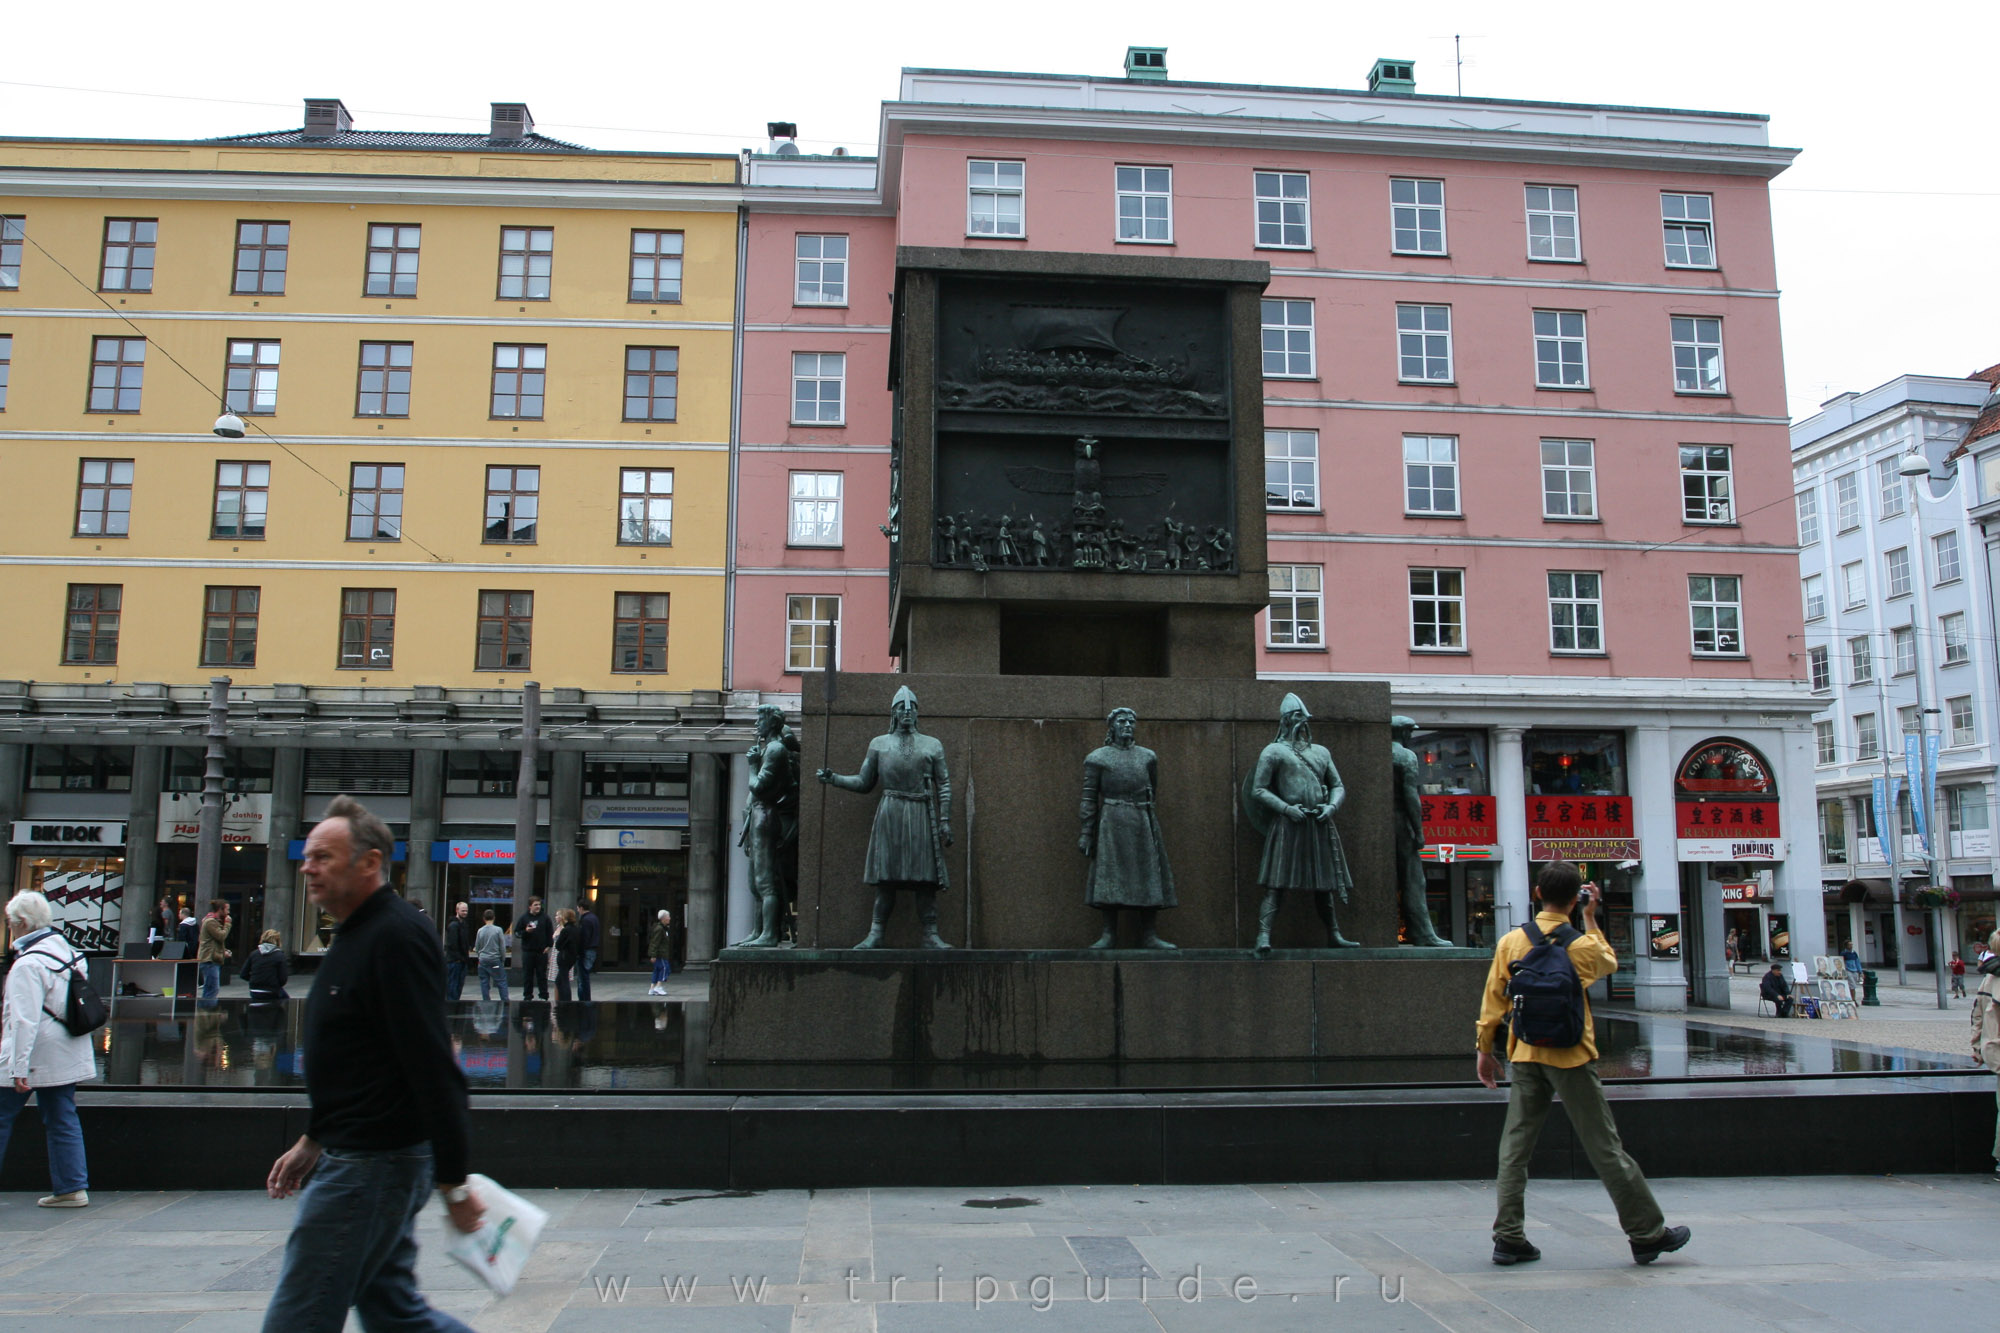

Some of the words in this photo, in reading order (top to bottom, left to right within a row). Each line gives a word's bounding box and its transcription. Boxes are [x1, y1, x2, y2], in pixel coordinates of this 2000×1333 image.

[1906, 738, 1914, 752] Tax
[232, 812, 263, 820] clothing
[1421, 800, 1486, 823] 宮酒樓
[31, 825, 63, 842] BIK
[62, 825, 104, 843] BOK
[1422, 826, 1490, 838] TAURANT
[1528, 827, 1573, 838] CHINA
[1577, 827, 1628, 837] PALACE
[1684, 827, 1772, 838] RESTAURANT
[473, 849, 495, 859] Star
[495, 849, 516, 859] Tour
[1441, 846, 1453, 863] 7
[1562, 851, 1610, 859] Restaurant
[1732, 843, 1775, 856] CHAMPIONS
[1722, 888, 1743, 900] KING
